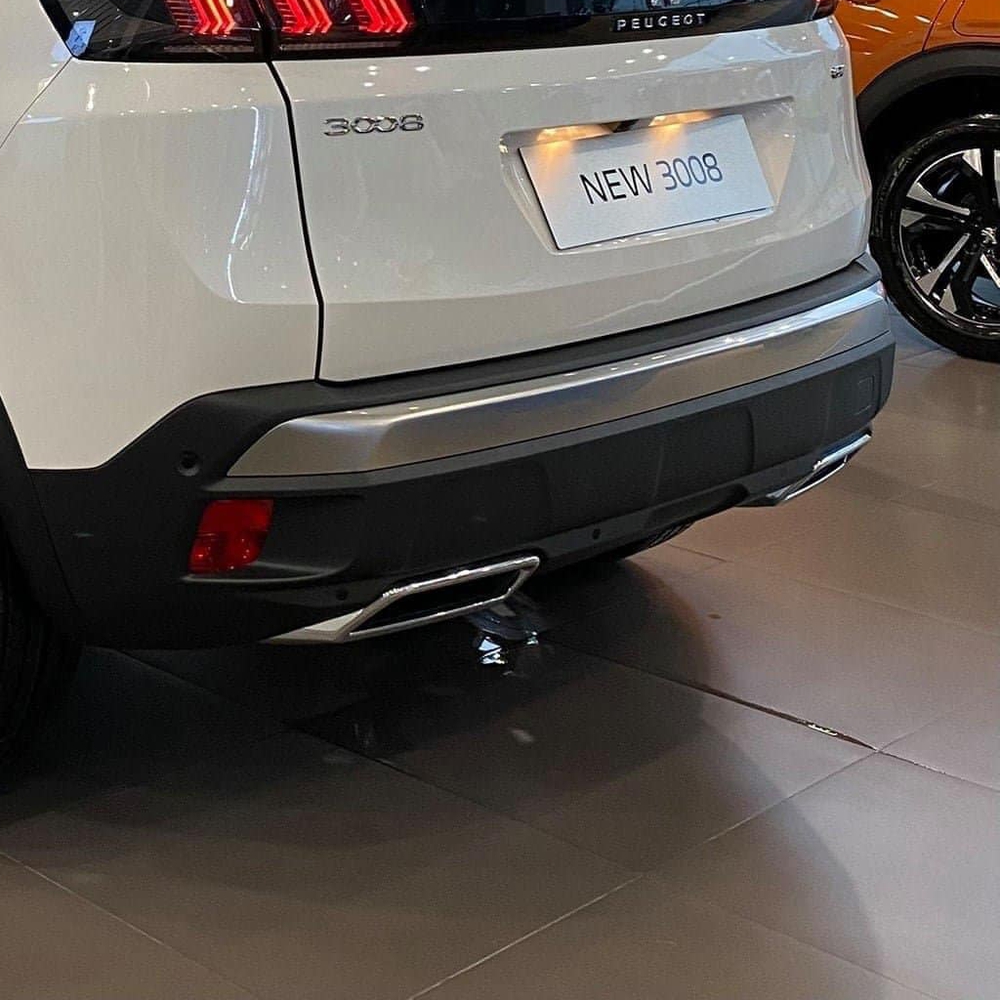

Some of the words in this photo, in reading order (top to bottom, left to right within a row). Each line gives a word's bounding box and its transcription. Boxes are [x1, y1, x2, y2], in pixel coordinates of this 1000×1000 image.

[616, 13, 706, 31] PEUGEOT
[323, 115, 424, 136] 3008
[579, 163, 653, 204] NEW
[655, 152, 723, 191] 3008
